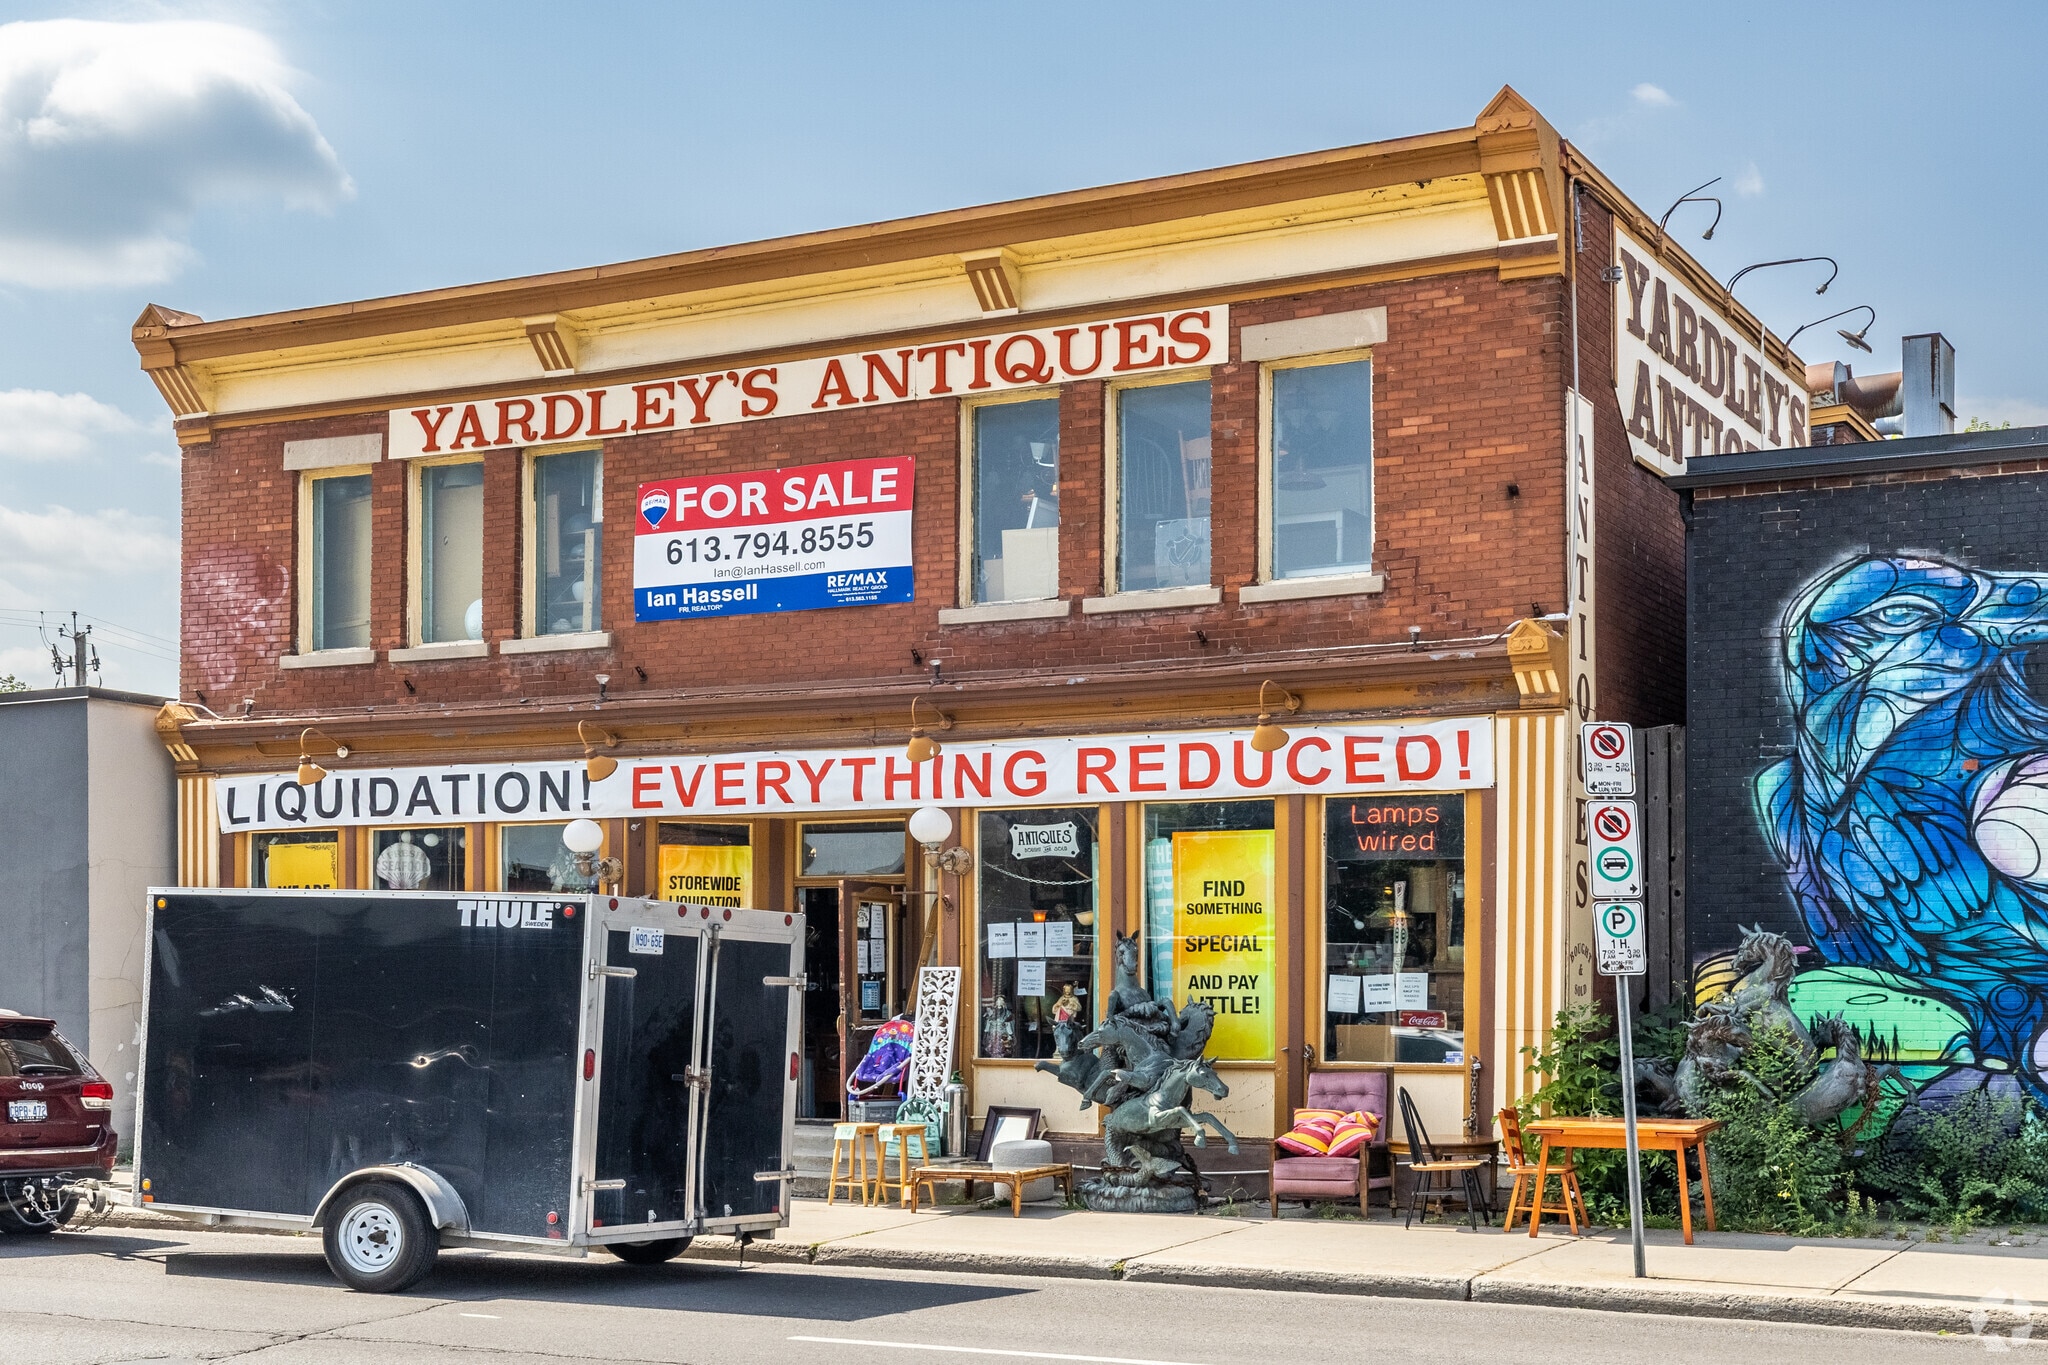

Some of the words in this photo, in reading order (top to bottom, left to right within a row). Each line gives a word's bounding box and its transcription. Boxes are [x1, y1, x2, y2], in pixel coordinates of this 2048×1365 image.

[1620, 247, 1806, 447] YARDLEY'S
[411, 368, 779, 453] YARDLEY'S
[811, 311, 1211, 408] ANTIQUES
[1627, 359, 1762, 464] ANTI
[675, 481, 769, 522] FOR
[783, 467, 898, 512] SALE
[666, 522, 874, 565] 613.794.8555
[713, 560, 826, 579] Ian@IanHassell.com
[827, 571, 888, 588] RE/MAX
[647, 591, 676, 607] Ian
[683, 583, 758, 604] Hassell
[227, 769, 591, 824] LIQUIDATION!
[632, 750, 1047, 809] EVERYTHING
[1077, 730, 1471, 795] REDUCED!
[1351, 804, 1440, 826] Lamps
[1018, 830, 1072, 845] ANTIQUES
[1358, 831, 1435, 851] wired
[669, 875, 742, 891] STOREWIDE
[1203, 880, 1245, 897] FIND
[457, 900, 554, 928] THULE
[1186, 902, 1263, 915] SOMETHING
[1612, 913, 1625, 929] P
[1185, 934, 1263, 952] SPECIAL
[1188, 975, 1223, 990] AND
[1228, 975, 1259, 990] PAY
[1200, 996, 1259, 1014] TTLE!
[20, 1081, 44, 1091] Jeep
